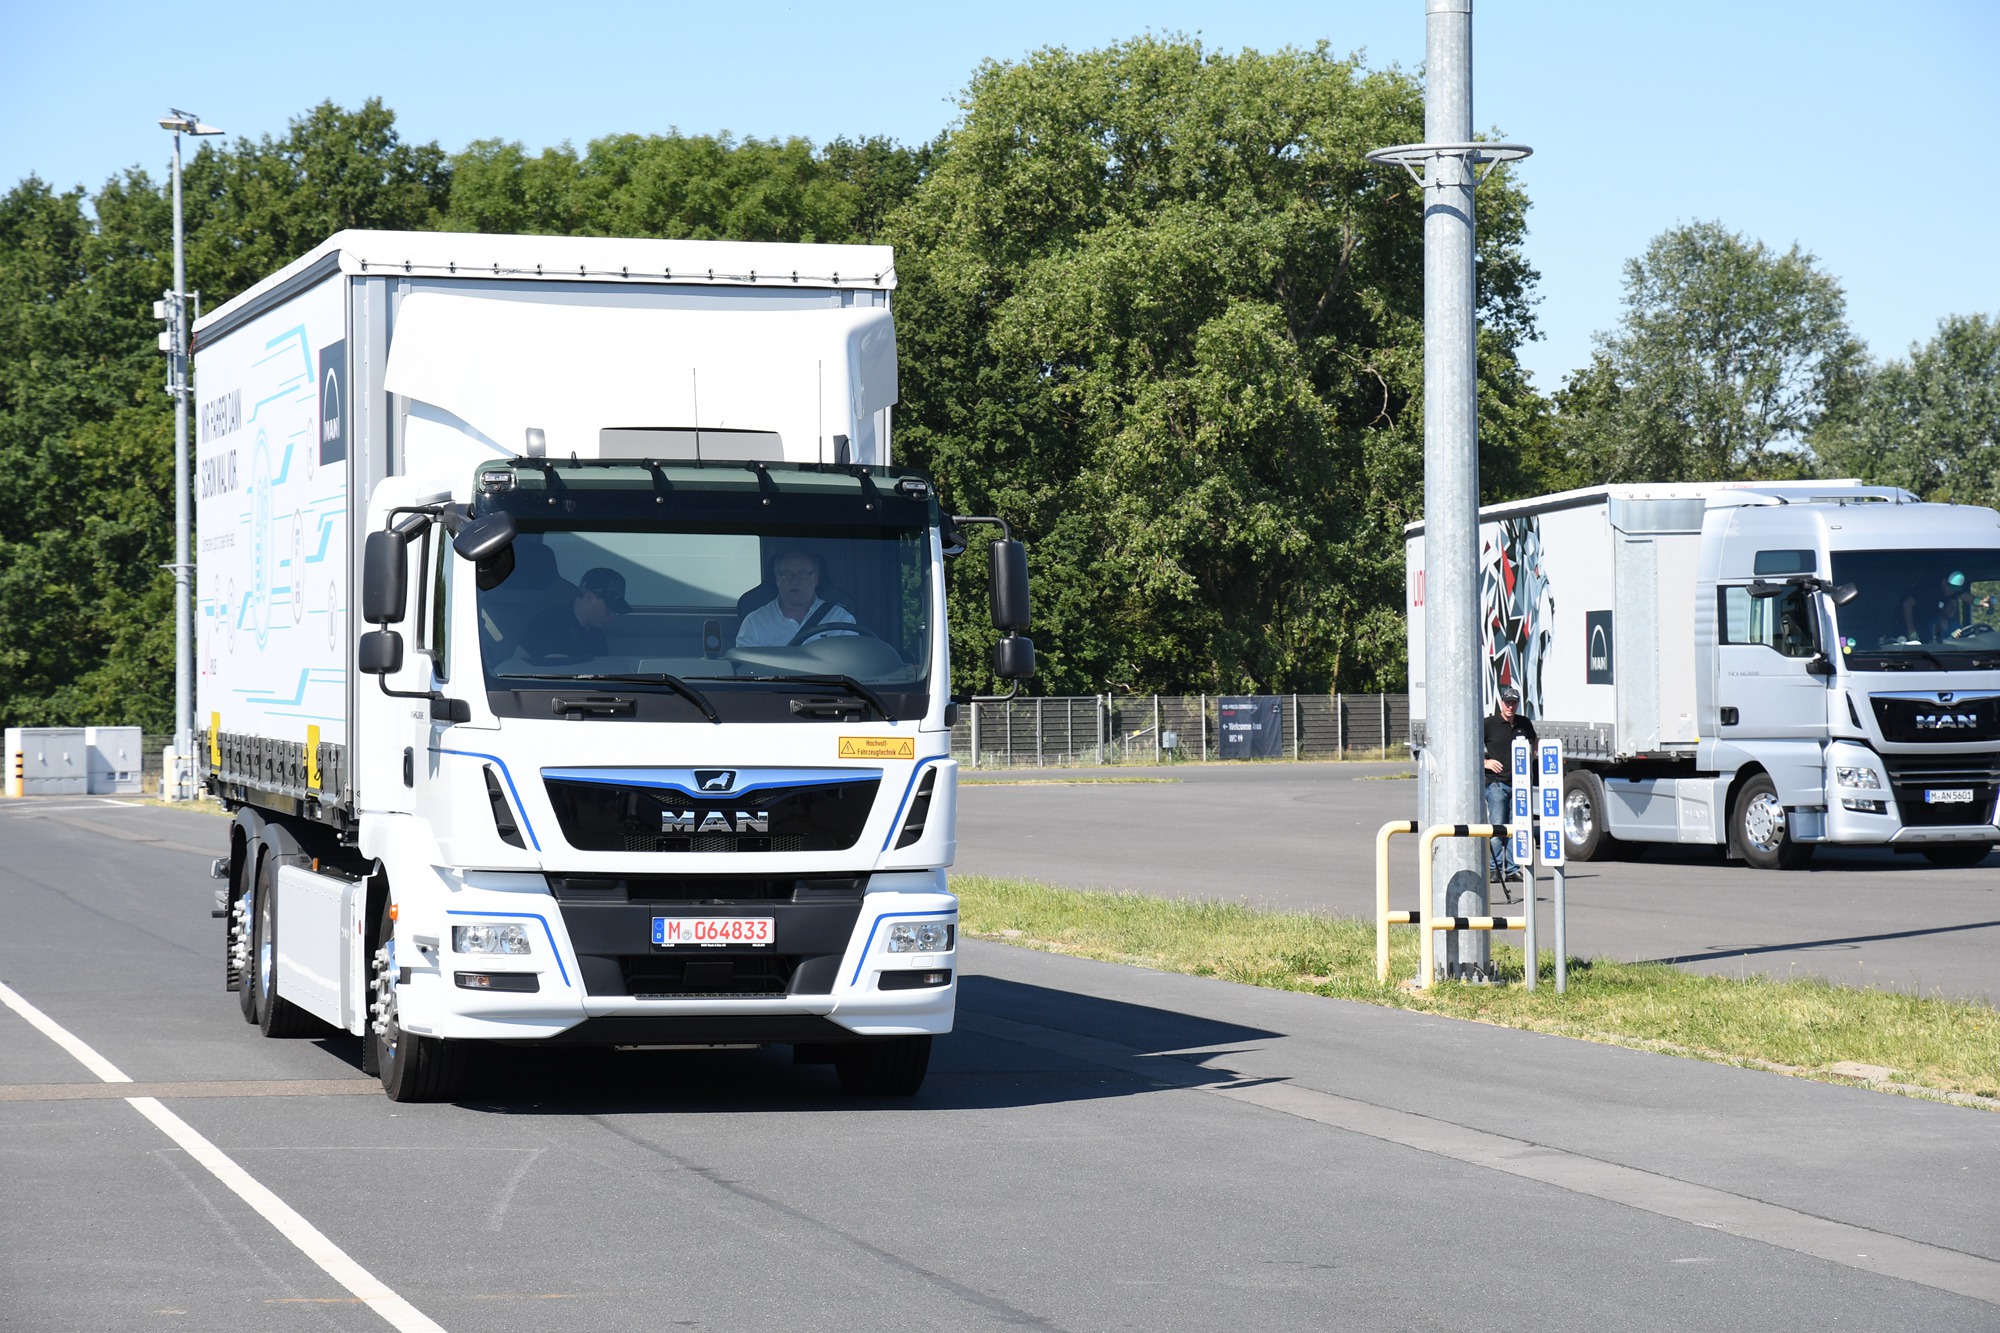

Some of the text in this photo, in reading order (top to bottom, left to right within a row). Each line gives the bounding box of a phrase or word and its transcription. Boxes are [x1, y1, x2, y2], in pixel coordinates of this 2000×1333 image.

[323, 417, 340, 442] MAN
[1590, 657, 1608, 671] MAN
[1916, 714, 1977, 729] MAN
[857, 748, 896, 757] Fahrzeugtechnik
[661, 811, 769, 832] MAN
[668, 921, 681, 940] M
[694, 921, 768, 940] 064833
